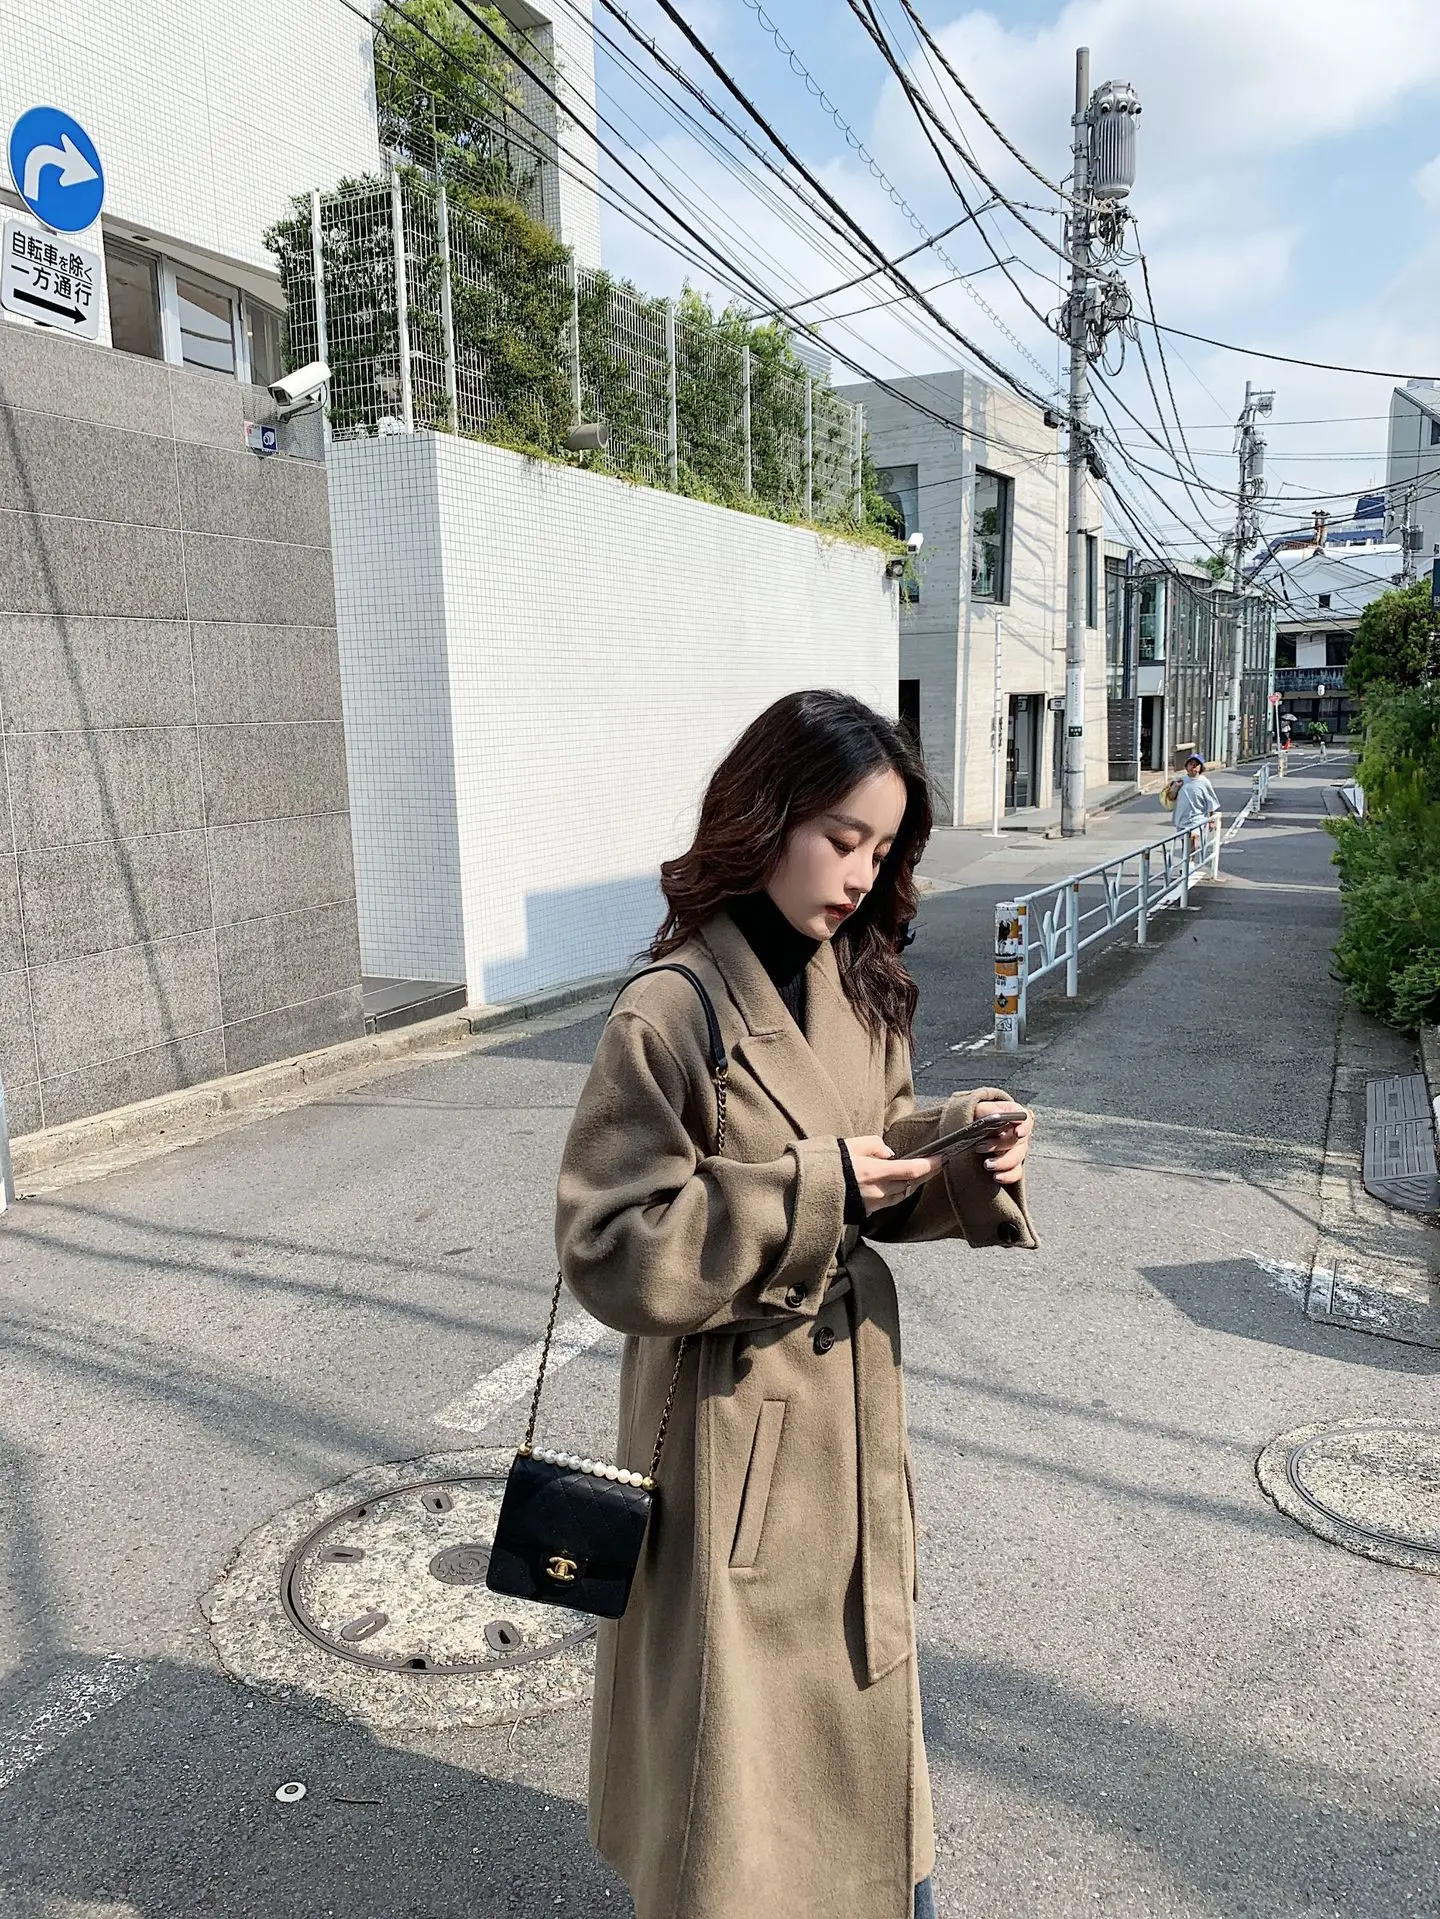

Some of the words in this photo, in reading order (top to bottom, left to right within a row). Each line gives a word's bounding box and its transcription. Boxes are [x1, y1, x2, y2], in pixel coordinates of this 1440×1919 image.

[12, 231, 92, 282] 自転車を除く
[11, 264, 92, 306] 一方通行
